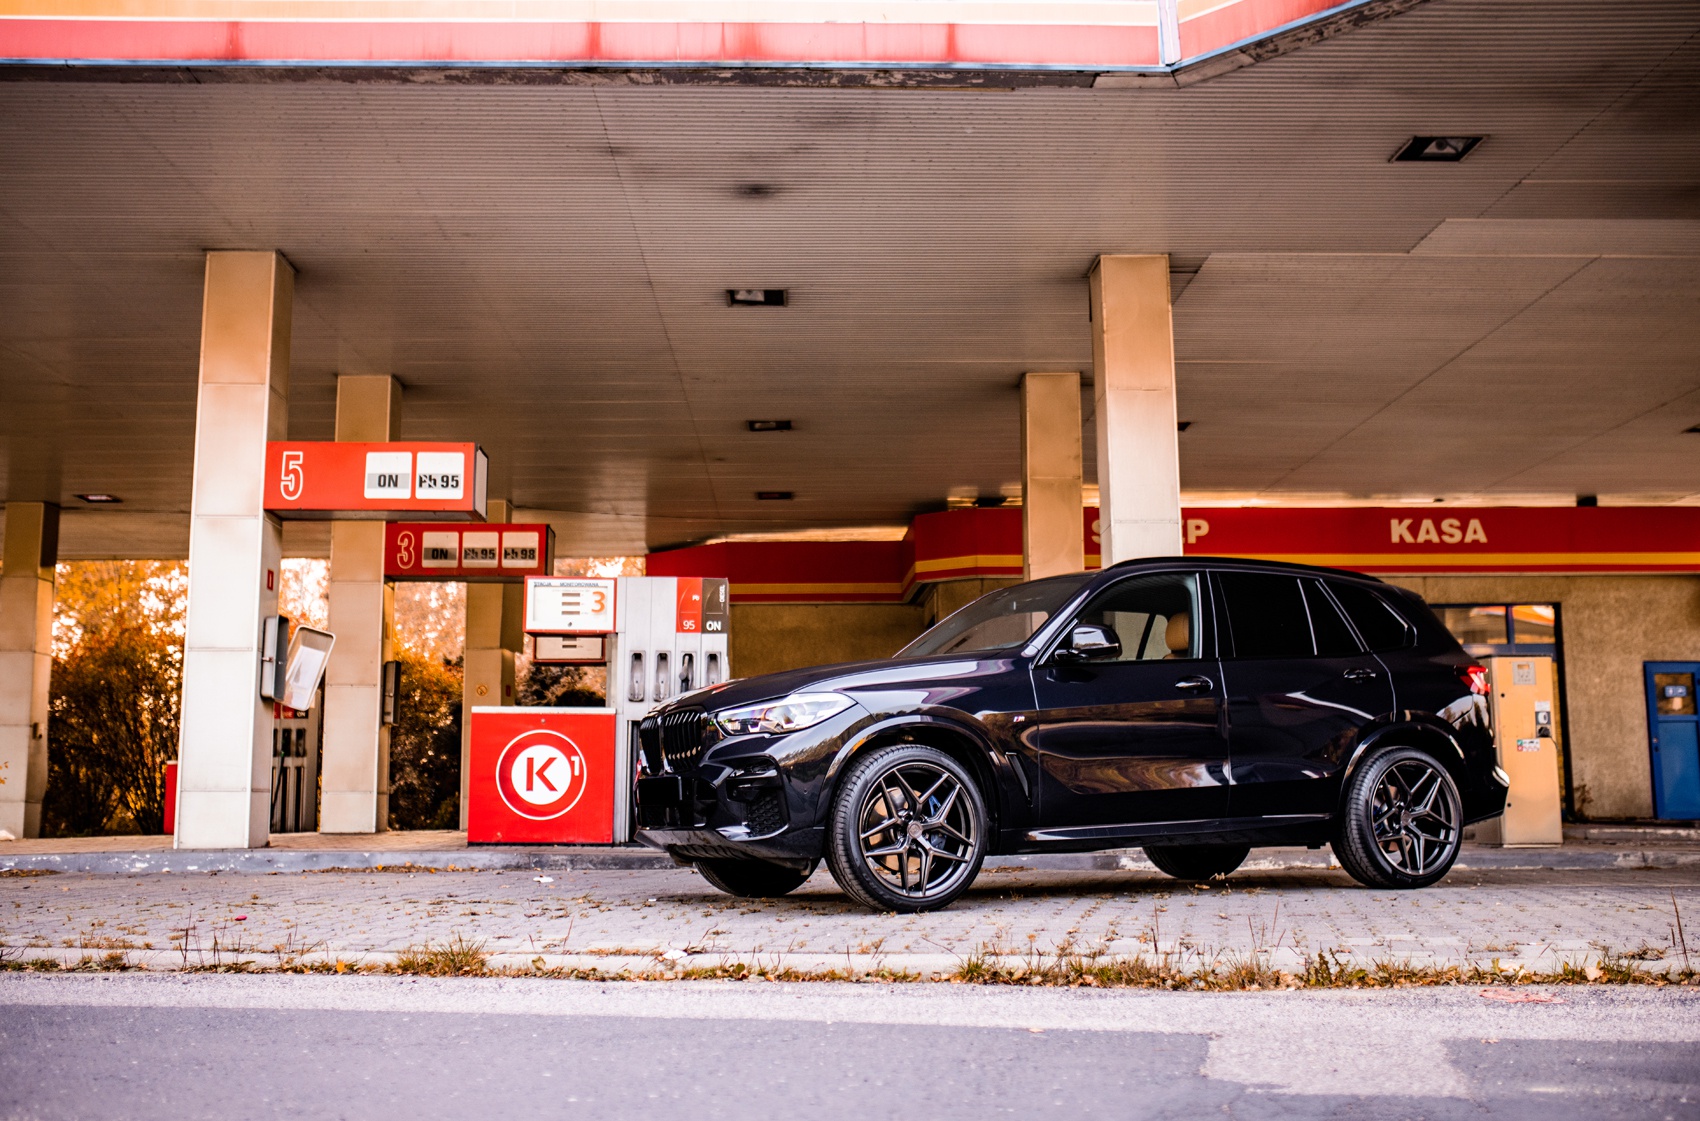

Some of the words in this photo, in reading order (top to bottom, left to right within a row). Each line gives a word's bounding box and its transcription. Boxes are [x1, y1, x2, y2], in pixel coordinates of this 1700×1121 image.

[280, 451, 303, 501] 5
[377, 473, 399, 488] ON
[441, 474, 459, 488] 95
[1390, 518, 1488, 544] KASA
[397, 530, 415, 569] 3
[431, 548, 448, 560] ON
[481, 548, 495, 560] 95
[521, 548, 535, 560] 98
[591, 591, 606, 613] 3
[683, 619, 695, 630] 95
[706, 620, 722, 631] ON
